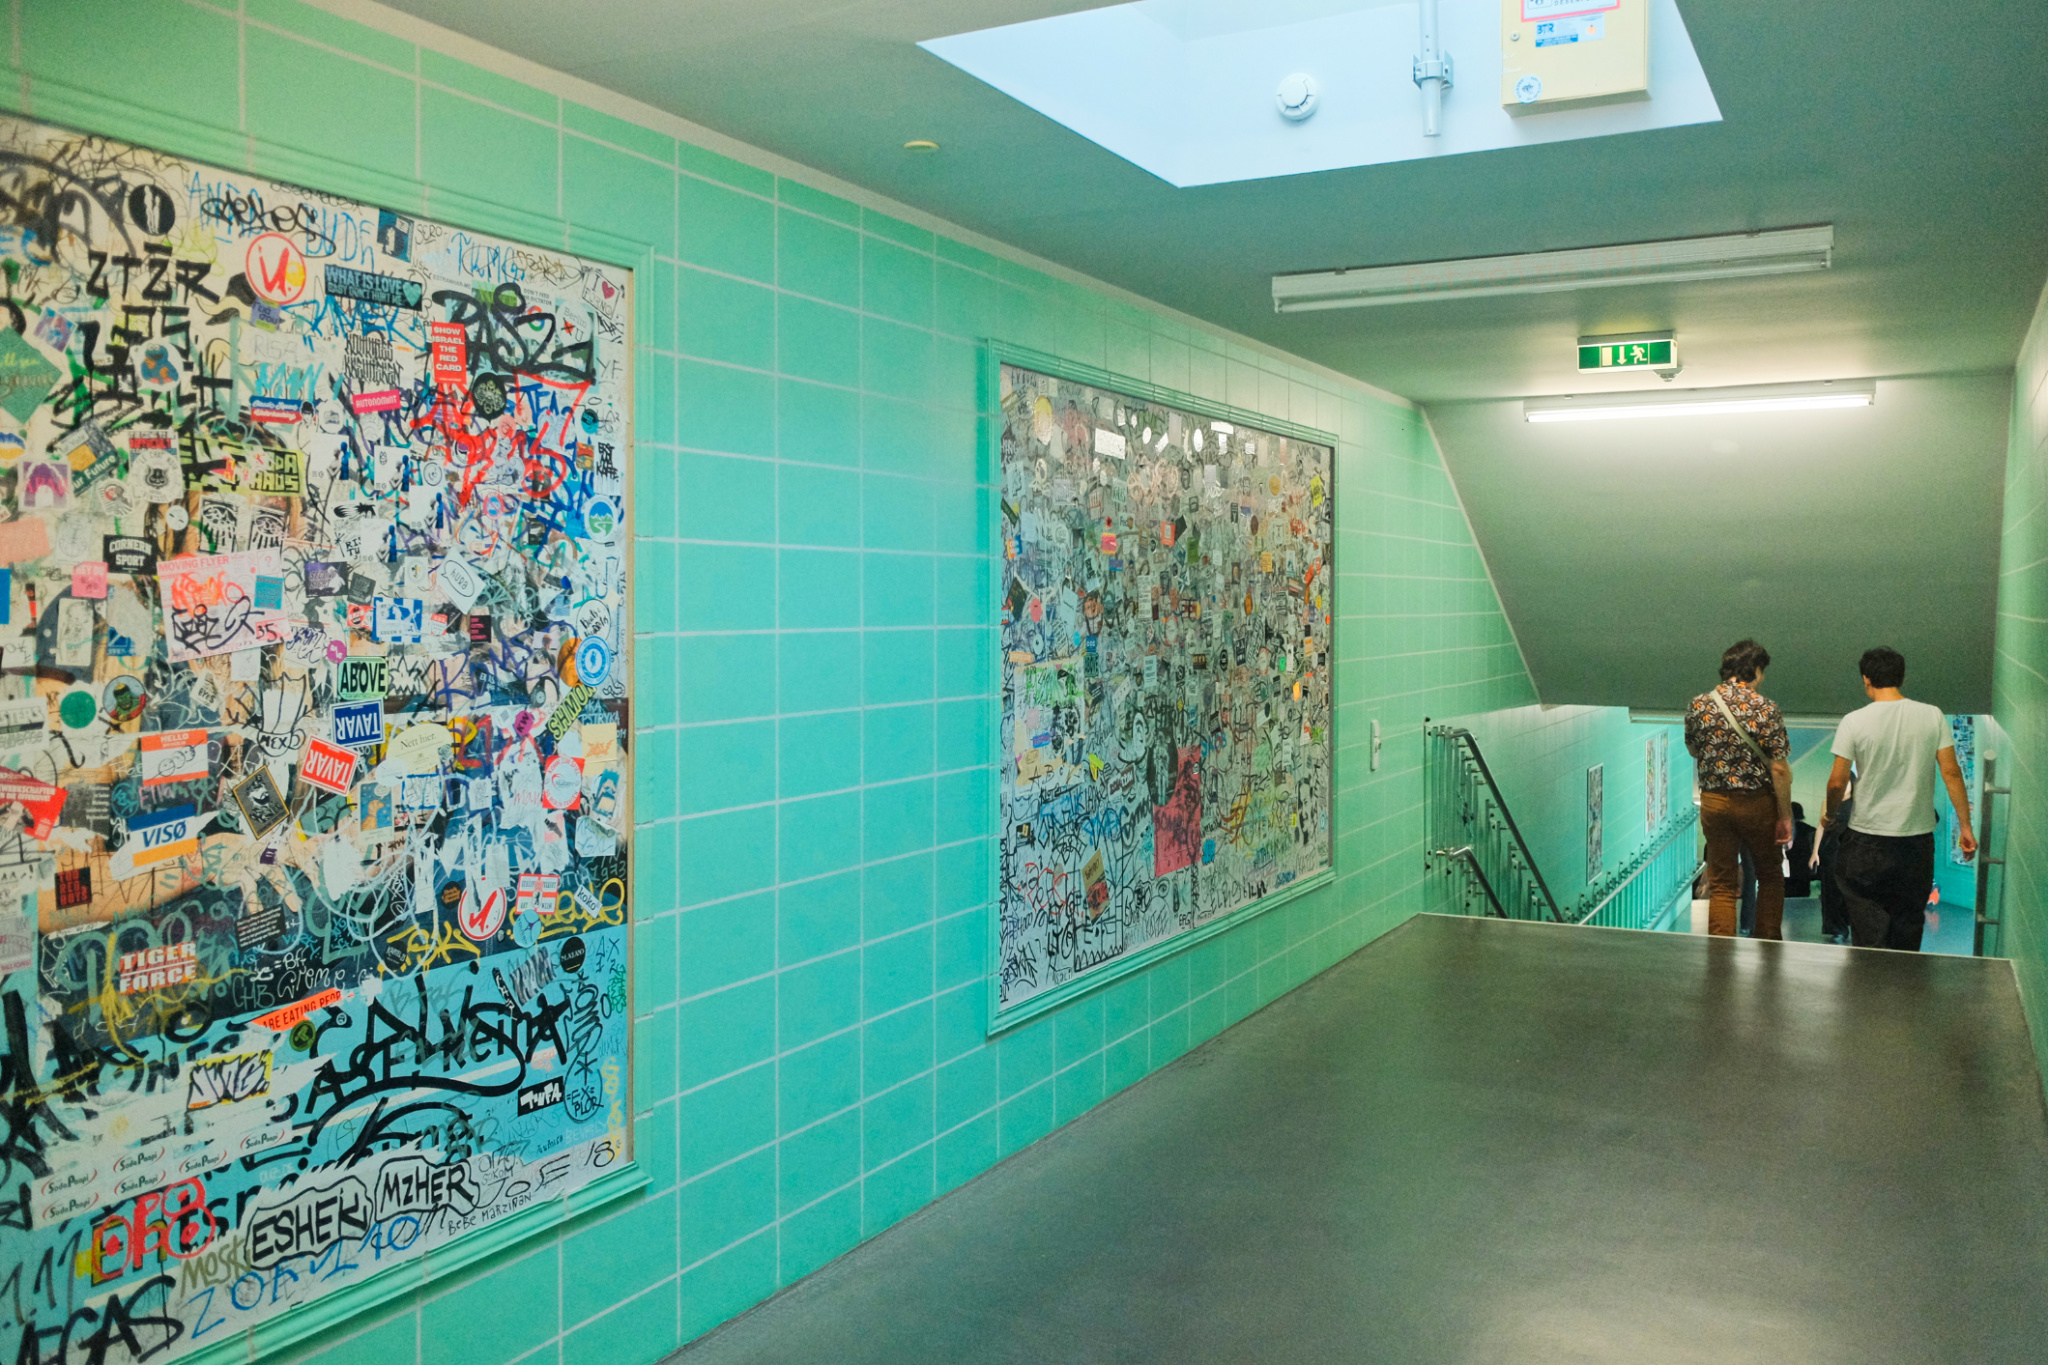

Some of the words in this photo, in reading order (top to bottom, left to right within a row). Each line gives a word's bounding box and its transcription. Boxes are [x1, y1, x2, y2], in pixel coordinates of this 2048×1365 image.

[325, 265, 362, 287] WHAT
[363, 274, 373, 290] IS
[376, 276, 402, 295] LOVE
[434, 326, 461, 335] SHOW
[430, 335, 465, 345] ISRAEL
[439, 345, 457, 353] THE
[436, 364, 462, 372] CARD
[84, 455, 116, 479] Future
[116, 554, 146, 567] SPORT
[158, 560, 198, 572] MOVING
[200, 555, 230, 568] FLYER
[340, 662, 386, 692] ABOVE
[161, 733, 189, 743] HELLO
[260, 735, 288, 750] MEX
[121, 942, 196, 969] TIGER
[120, 964, 196, 994] FORCE
[283, 1000, 317, 1025] EATING
